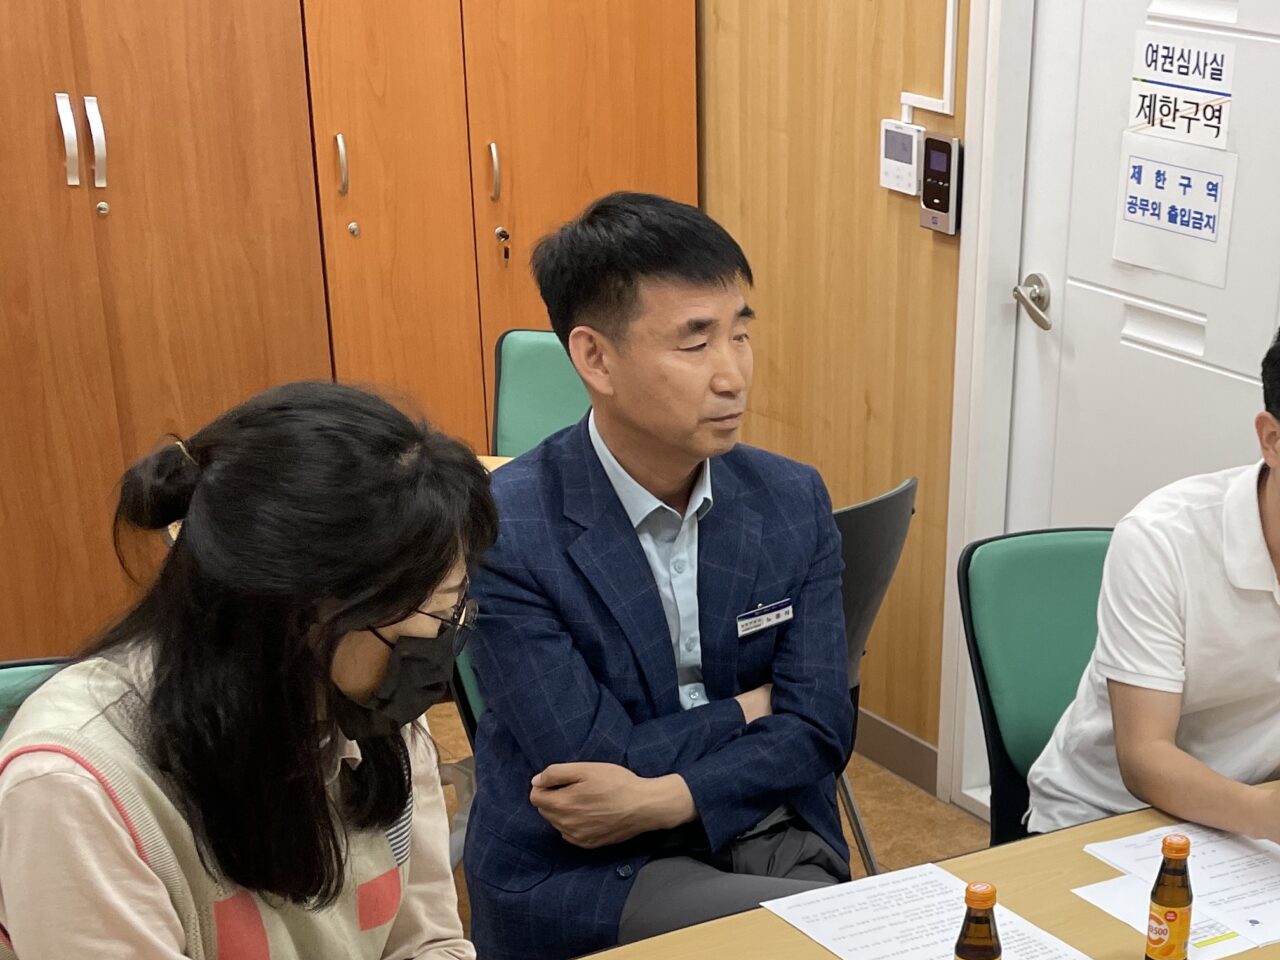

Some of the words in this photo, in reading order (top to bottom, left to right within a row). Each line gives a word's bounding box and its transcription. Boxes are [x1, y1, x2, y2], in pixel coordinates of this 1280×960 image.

[1145, 42, 1225, 82] 여권심사실
[1136, 93, 1223, 139] 제한구역
[1127, 195, 1162, 220] 공무외
[1167, 204, 1217, 233] 출입금지
